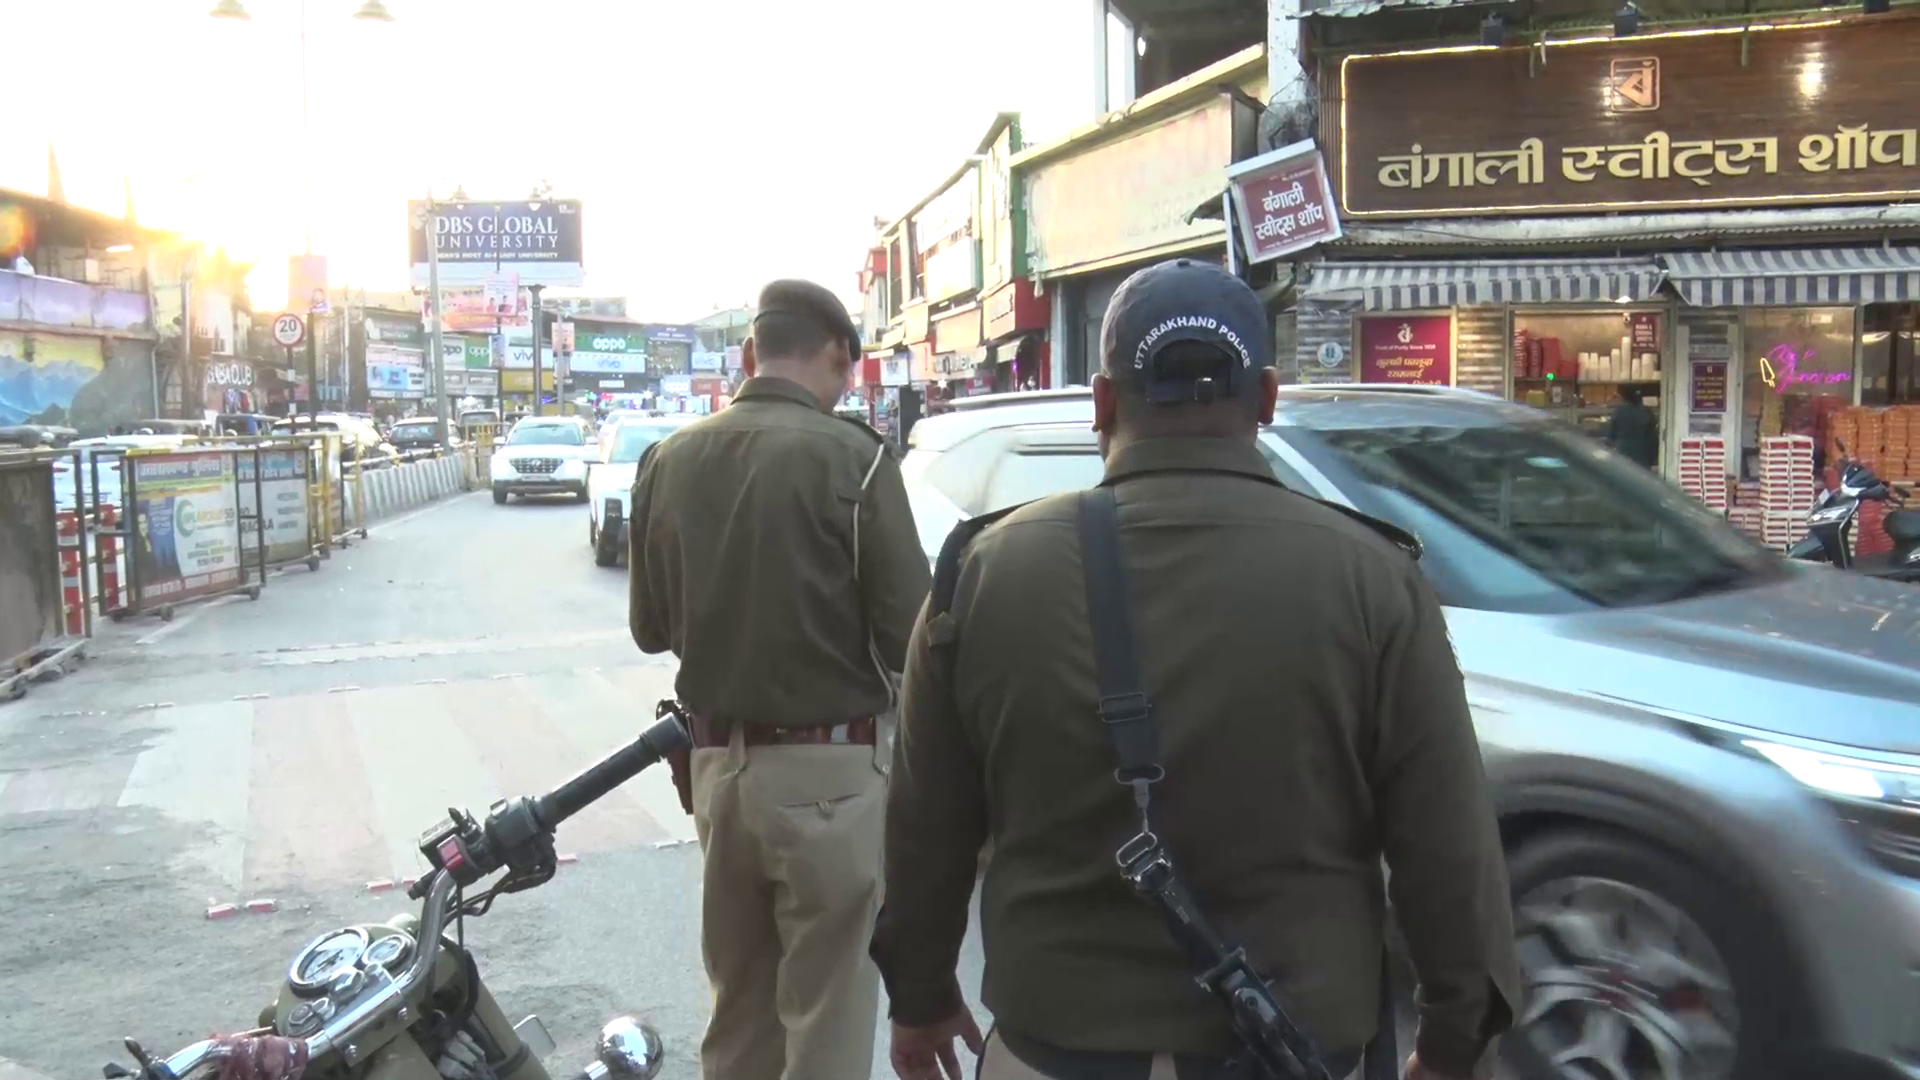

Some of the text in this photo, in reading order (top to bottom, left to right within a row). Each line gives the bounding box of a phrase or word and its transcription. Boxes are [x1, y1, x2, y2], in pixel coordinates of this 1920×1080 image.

[1378, 122, 1917, 189] बंगाली स्वीट्स शॉप
[1262, 181, 1305, 212] बंगाली
[435, 216, 559, 234] DBS GLOBAL
[1254, 214, 1296, 240] स्वीट्स
[1297, 202, 1324, 227] शॉप
[436, 235, 559, 248] UNIVERSITY
[280, 319, 297, 333] 20
[593, 336, 626, 351] oppo
[1134, 315, 1251, 369] UTTARAKHAND POLICE
[513, 349, 534, 361] viv
